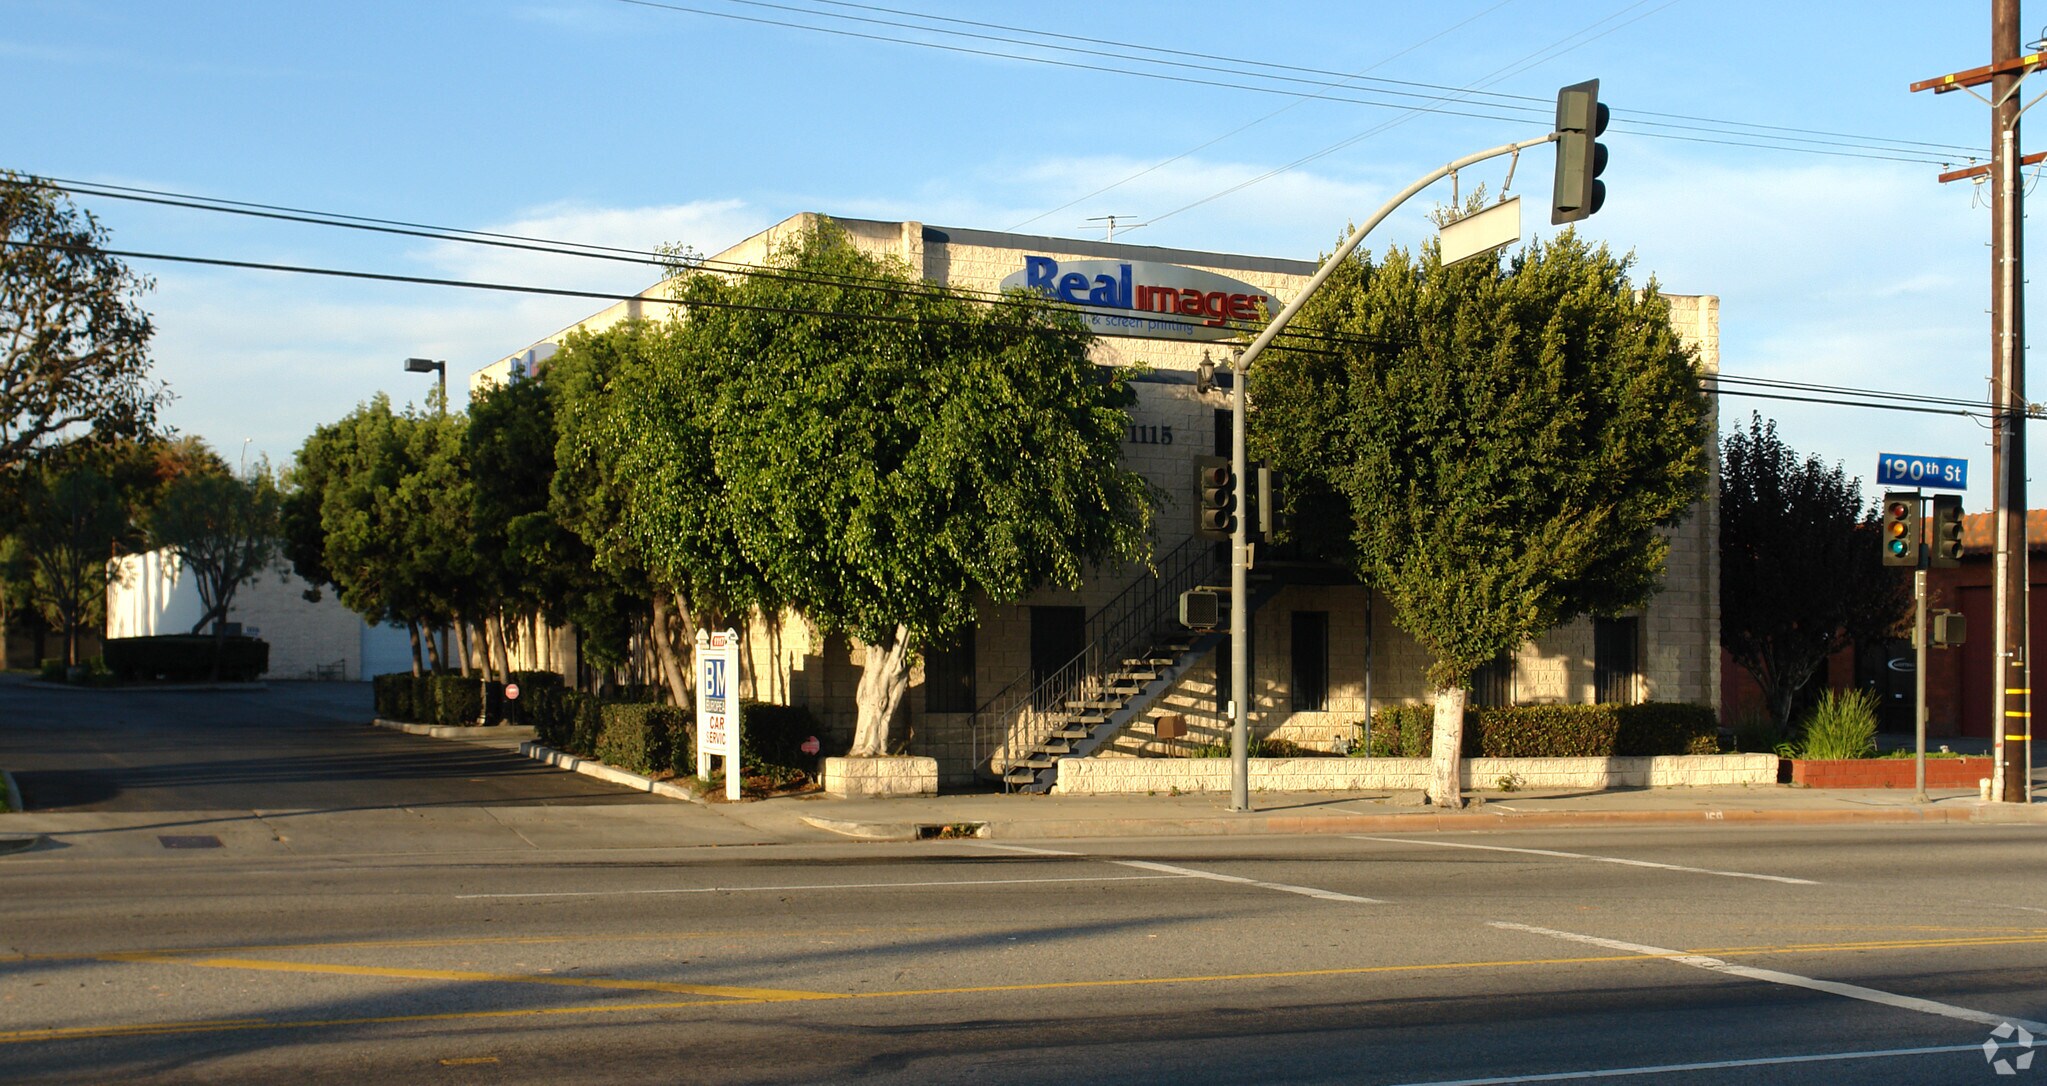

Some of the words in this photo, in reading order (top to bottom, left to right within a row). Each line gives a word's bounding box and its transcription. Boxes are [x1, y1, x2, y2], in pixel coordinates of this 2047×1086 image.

[1024, 255, 1132, 309] Real
[1105, 315, 1143, 329] screen
[1148, 319, 1193, 335] printing
[1885, 458, 1939, 481] 190th
[1944, 465, 1961, 482] St
[705, 661, 726, 696] BM
[709, 716, 725, 730] CAR
[706, 731, 726, 745] SERVIC
